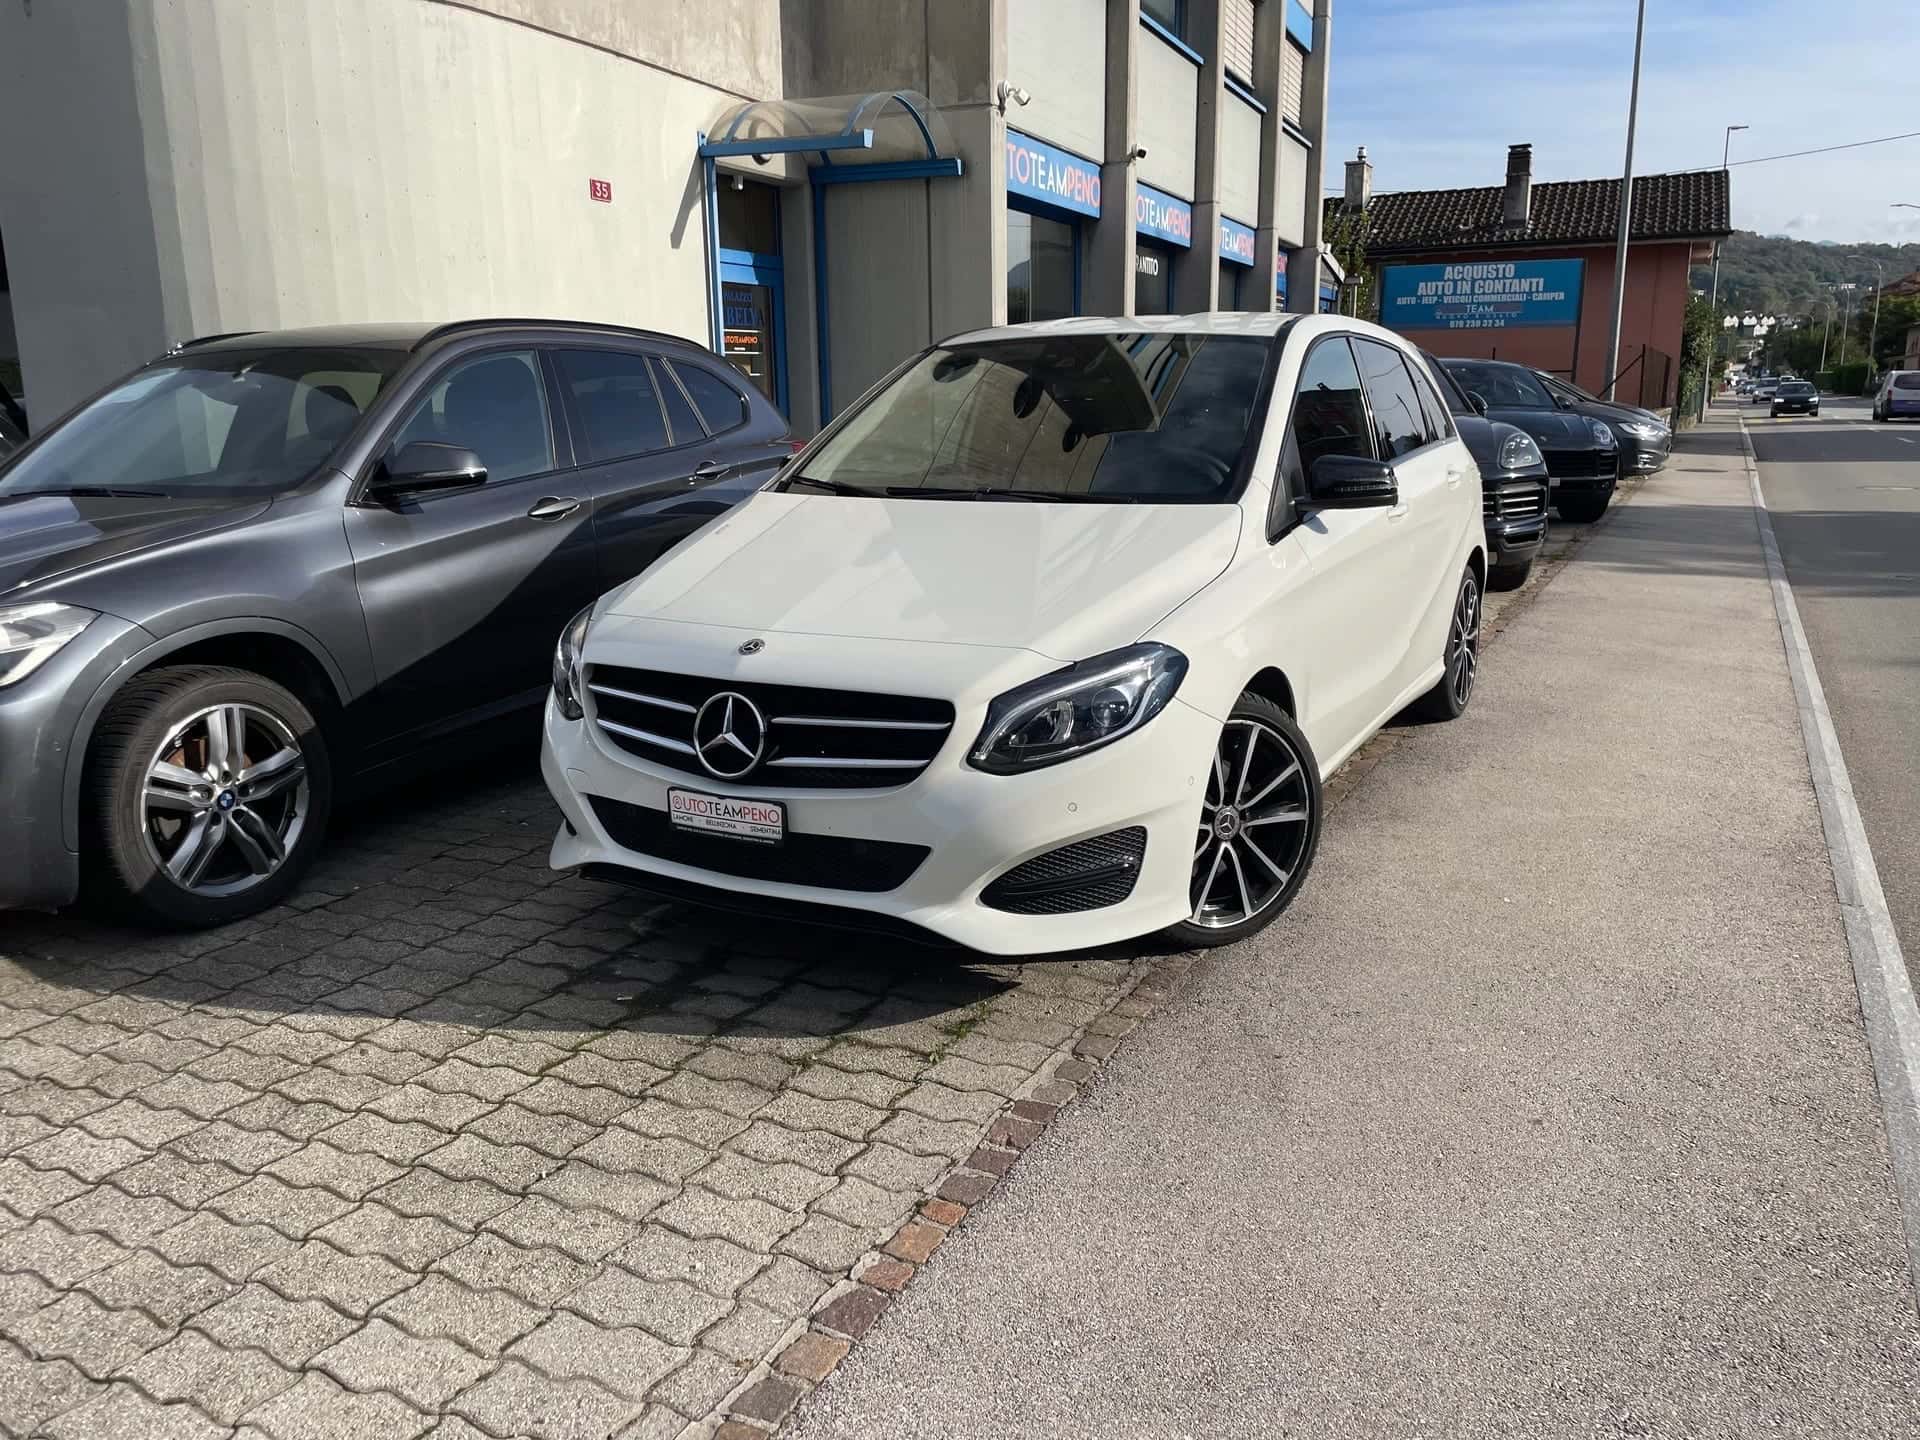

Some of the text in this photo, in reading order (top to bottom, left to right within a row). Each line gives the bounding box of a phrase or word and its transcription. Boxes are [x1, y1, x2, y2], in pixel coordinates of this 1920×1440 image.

[1007, 142, 1101, 208] TOTEAMPENO
[595, 182, 609, 198] 35
[1136, 195, 1191, 238] OTEAMPENO
[1136, 254, 1159, 276] RANTITO
[1444, 264, 1515, 280] ACQUISTO
[1417, 278, 1544, 296] AUTO IN CONTANTI
[1396, 297, 1416, 305] AUTO
[1422, 296, 1438, 304] JEEP
[1443, 295, 1472, 304] VEICOLI
[1473, 293, 1526, 303] COMMERCIALI
[1532, 292, 1564, 301] CAMPER
[1466, 304, 1495, 313] TEAM
